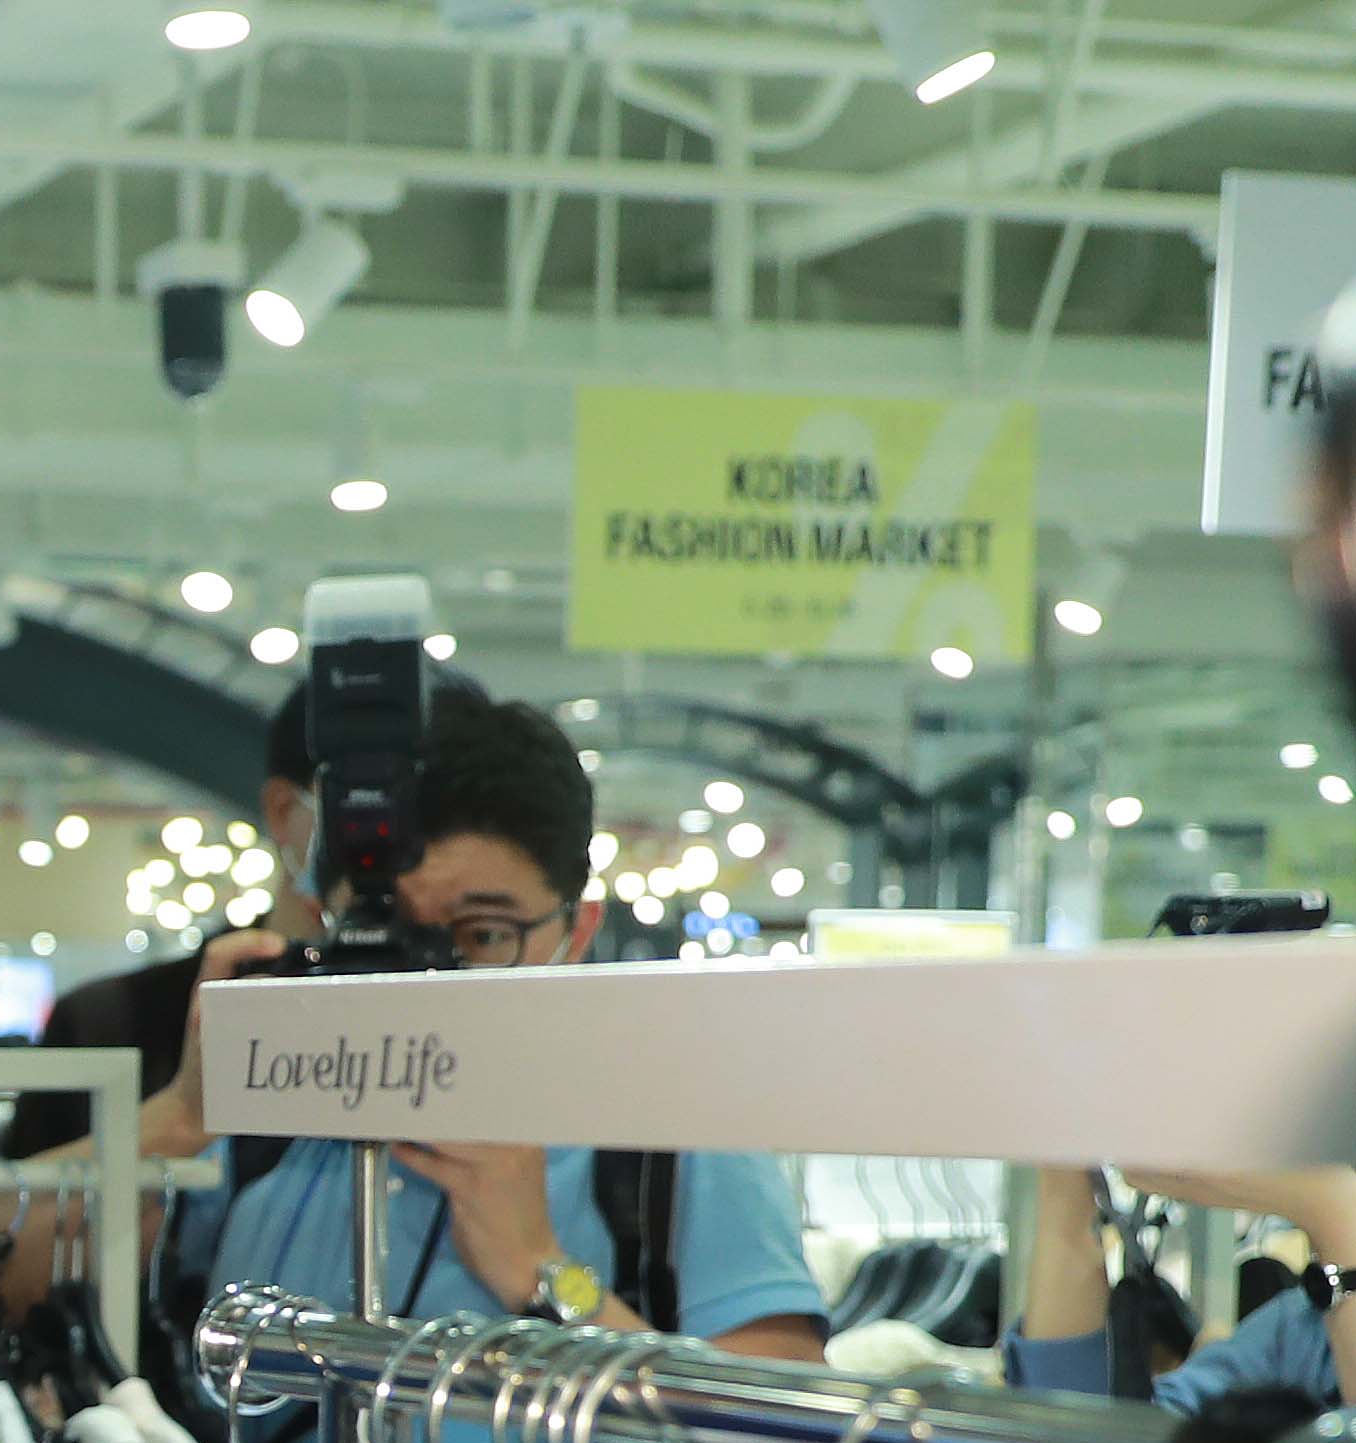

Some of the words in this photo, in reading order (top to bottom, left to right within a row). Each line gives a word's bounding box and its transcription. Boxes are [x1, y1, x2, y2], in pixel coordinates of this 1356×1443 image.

[727, 455, 879, 503] KOREA
[606, 510, 796, 563] FASHION
[809, 516, 994, 568] MARKET
[245, 1034, 370, 1110] Lovely
[377, 1031, 458, 1108] Life
